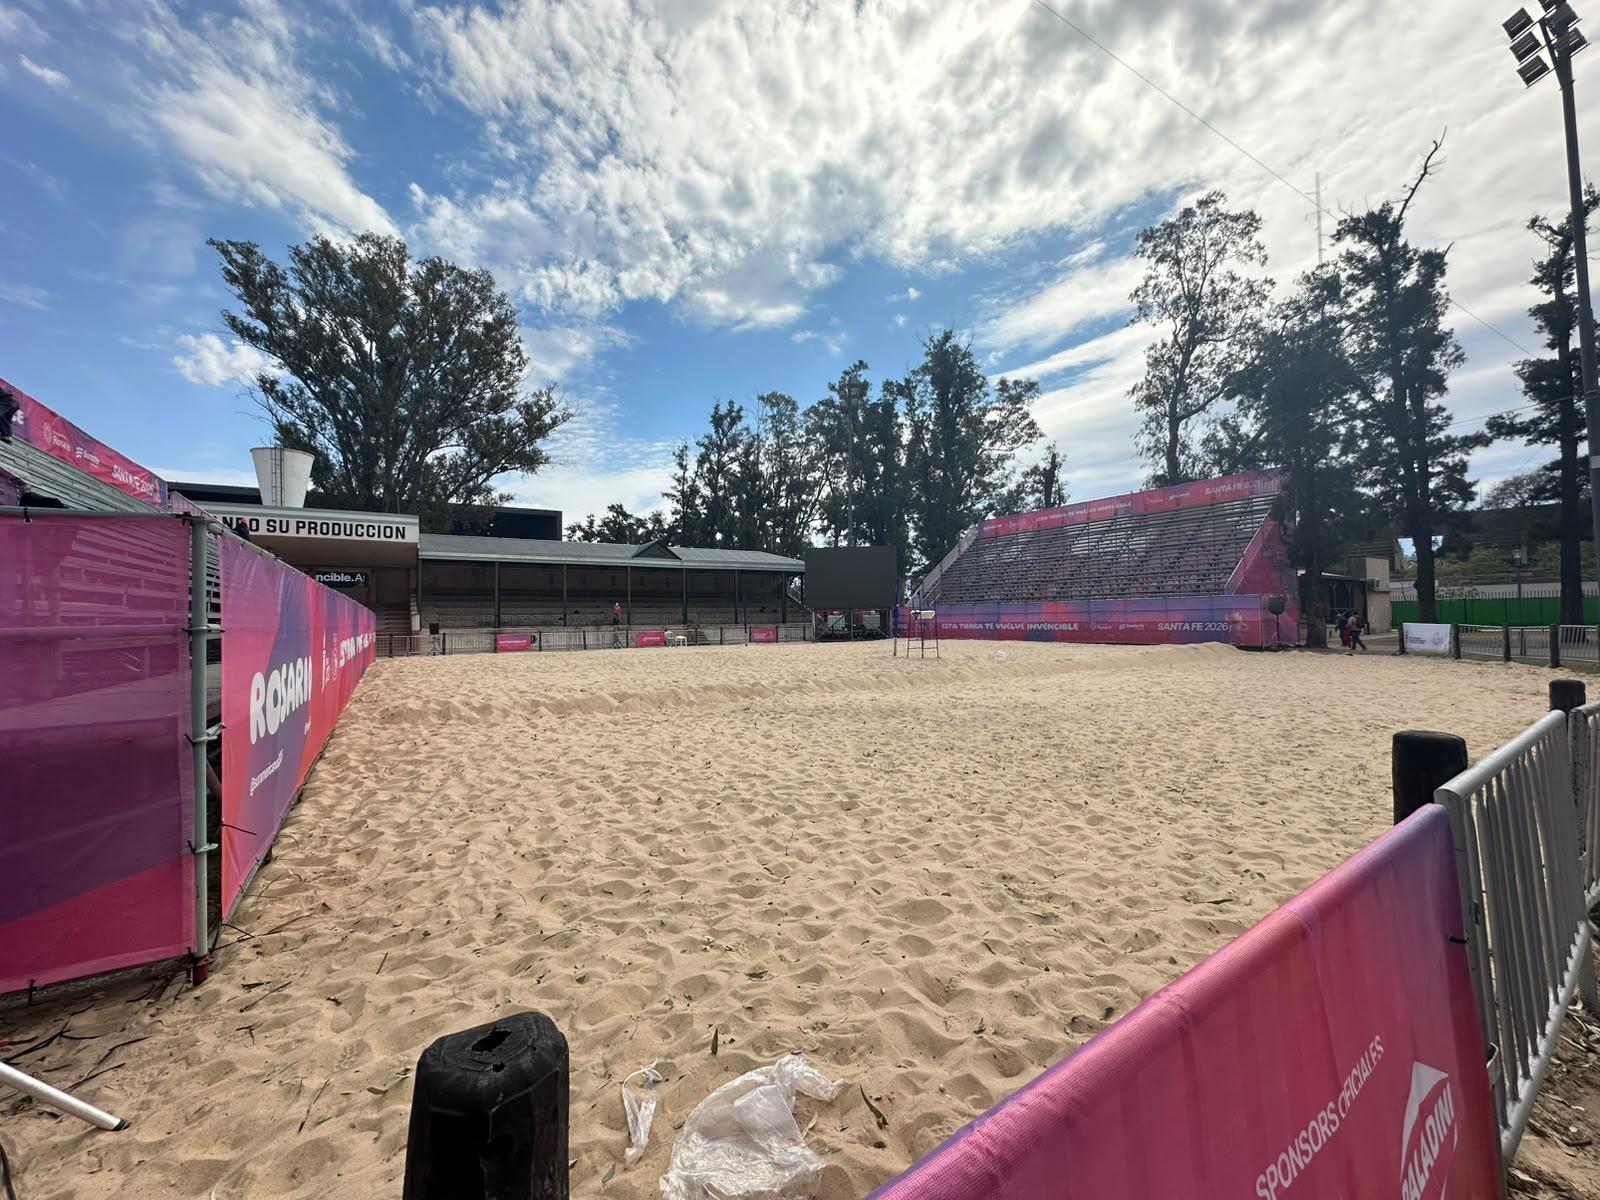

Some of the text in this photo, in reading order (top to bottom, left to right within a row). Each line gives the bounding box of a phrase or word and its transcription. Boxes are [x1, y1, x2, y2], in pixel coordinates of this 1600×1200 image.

[266, 518, 290, 533] SU
[296, 520, 406, 540] PRODUCCION
[1157, 622, 1228, 631] SANTA FE 2026
[1256, 1101, 1340, 1200] SPONSORS
